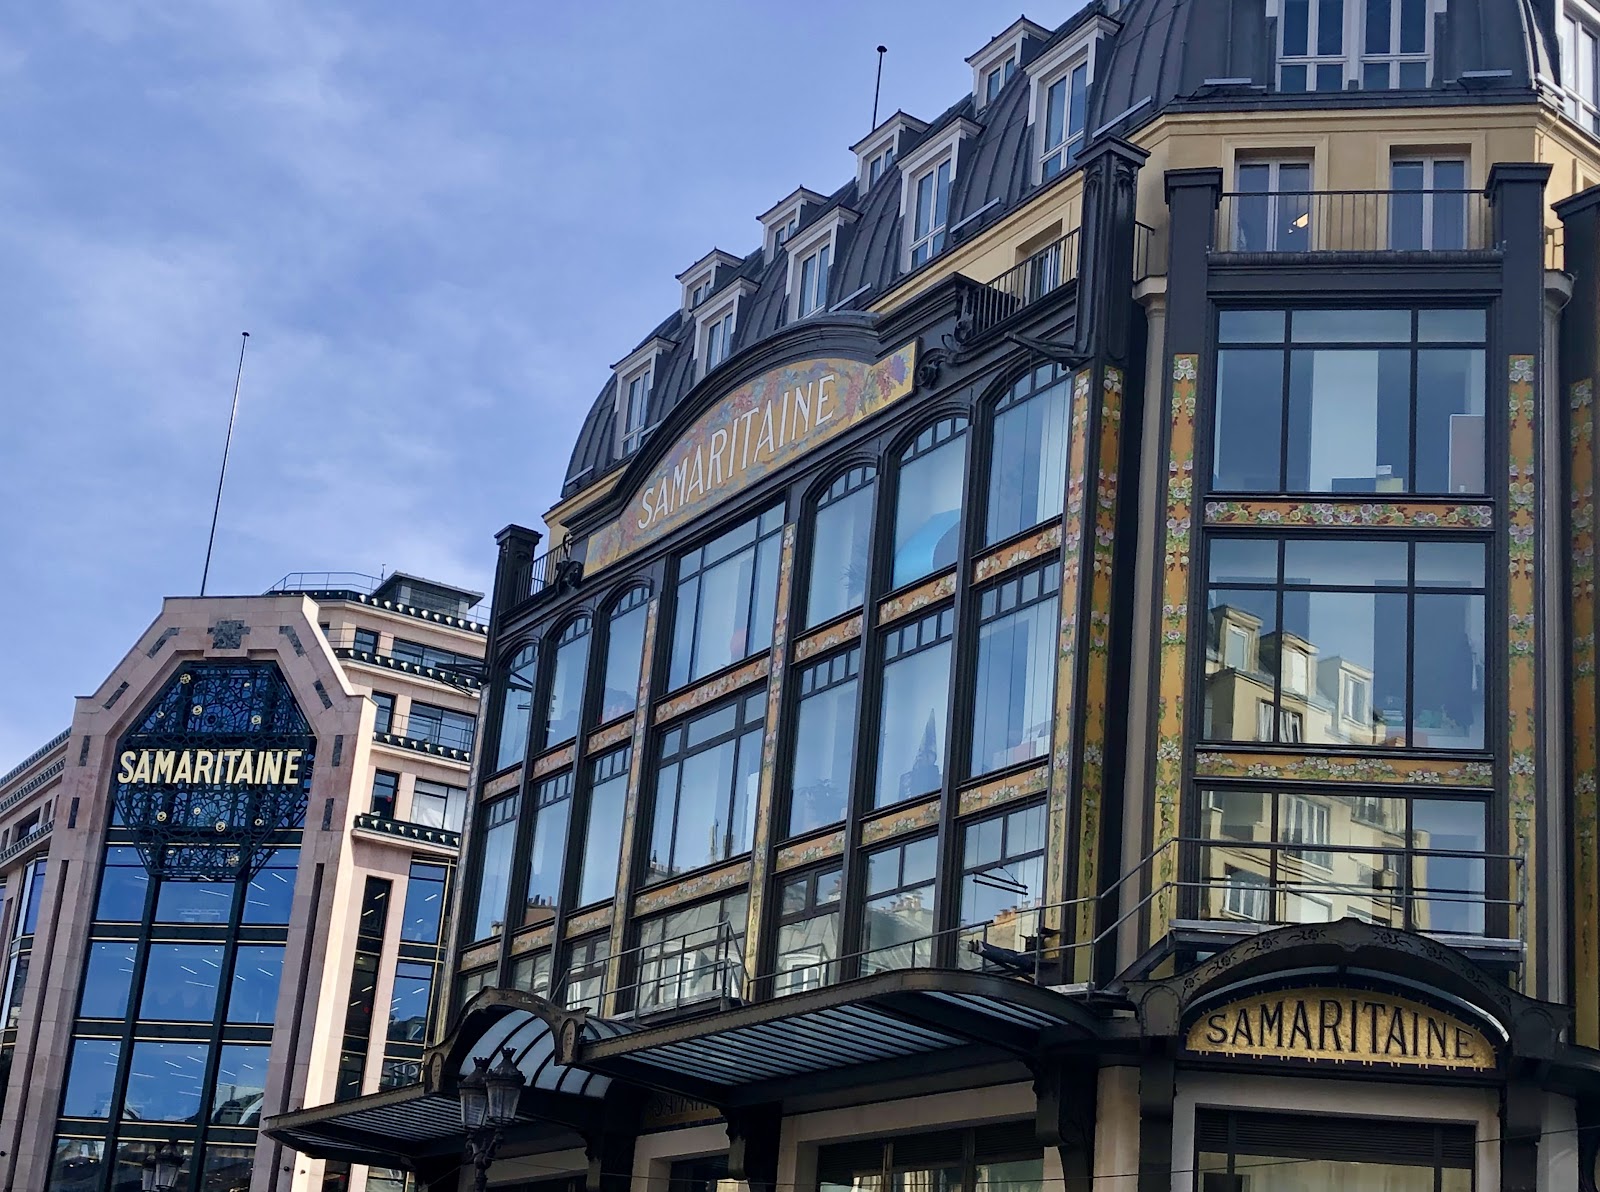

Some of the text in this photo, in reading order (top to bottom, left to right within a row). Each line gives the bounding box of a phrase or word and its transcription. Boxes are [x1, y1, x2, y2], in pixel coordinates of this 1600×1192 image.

[637, 374, 836, 530] SAMARITAINE
[117, 750, 302, 785] SAMARITAINE
[1206, 999, 1475, 1059] SAMARITAINE
